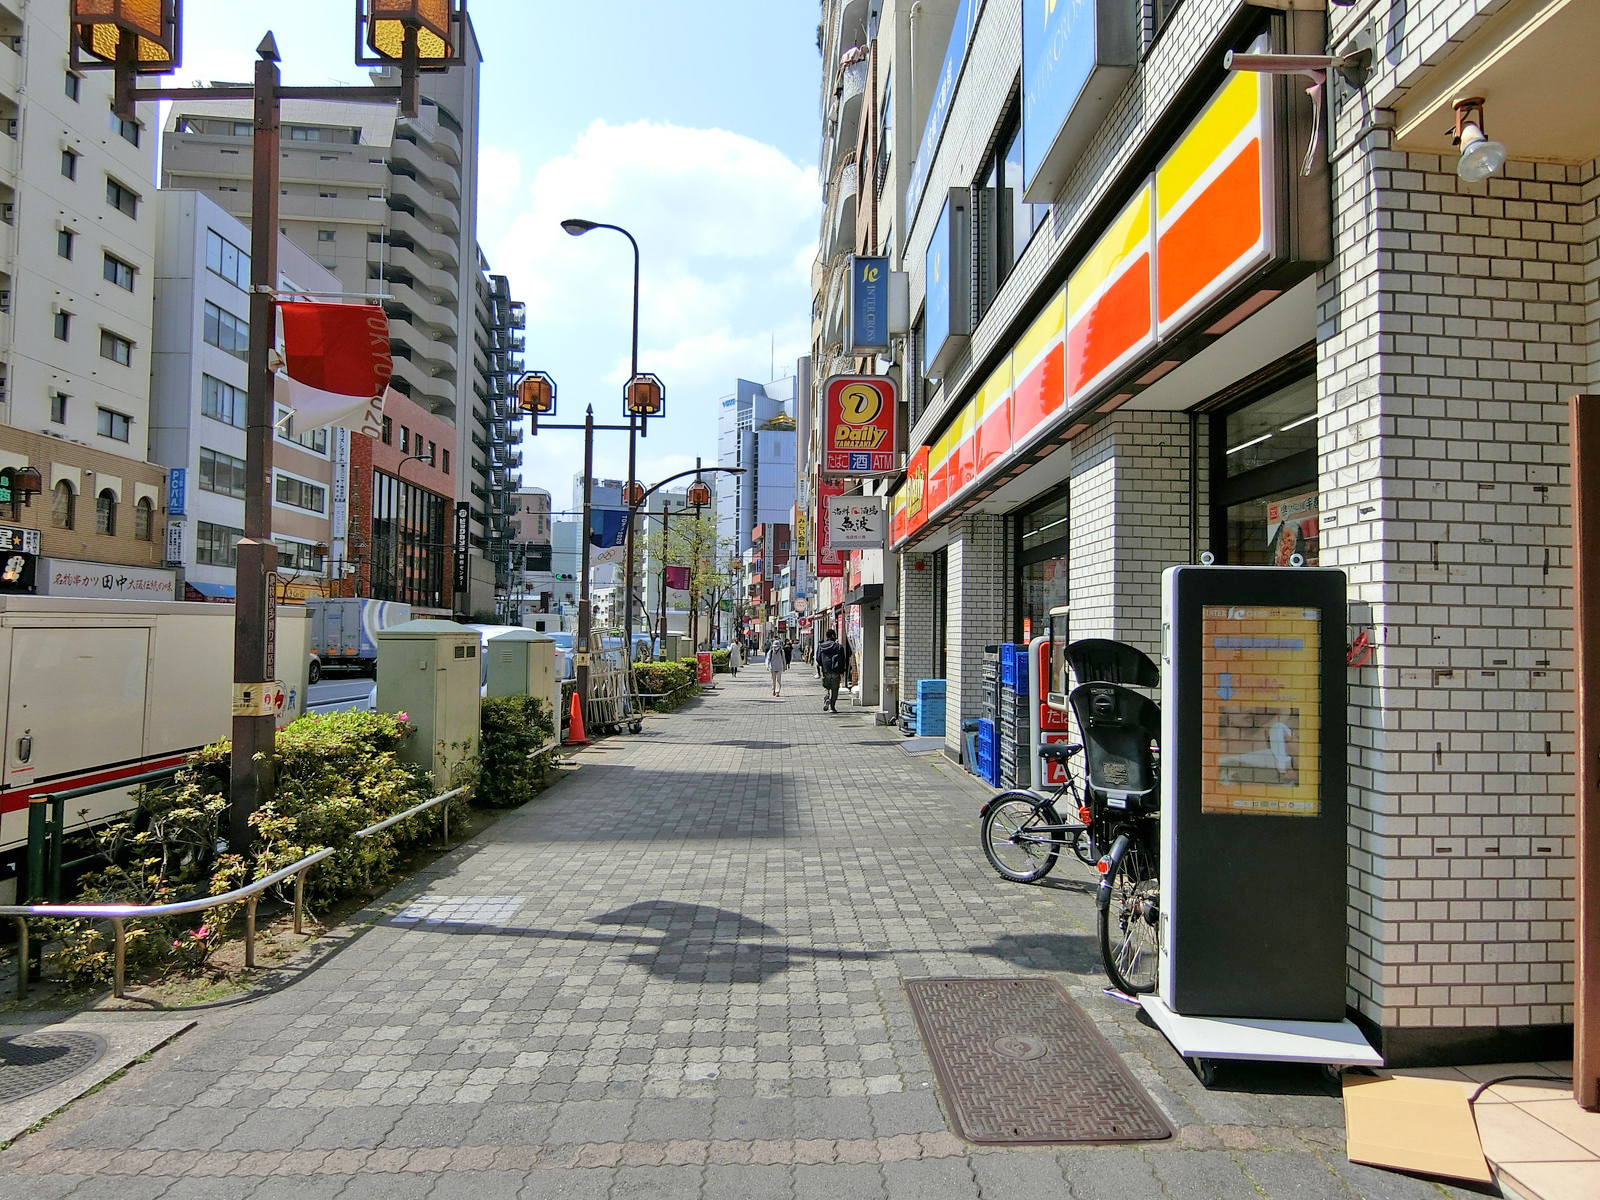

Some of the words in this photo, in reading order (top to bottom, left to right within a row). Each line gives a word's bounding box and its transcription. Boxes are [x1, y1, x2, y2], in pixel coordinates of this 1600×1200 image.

[835, 425, 888, 448] Daily
[835, 440, 872, 448] YAMAZAKI
[828, 454, 848, 468] たばこ
[852, 453, 867, 469] 酒
[873, 455, 891, 469] ATM
[102, 574, 128, 592] 田中
